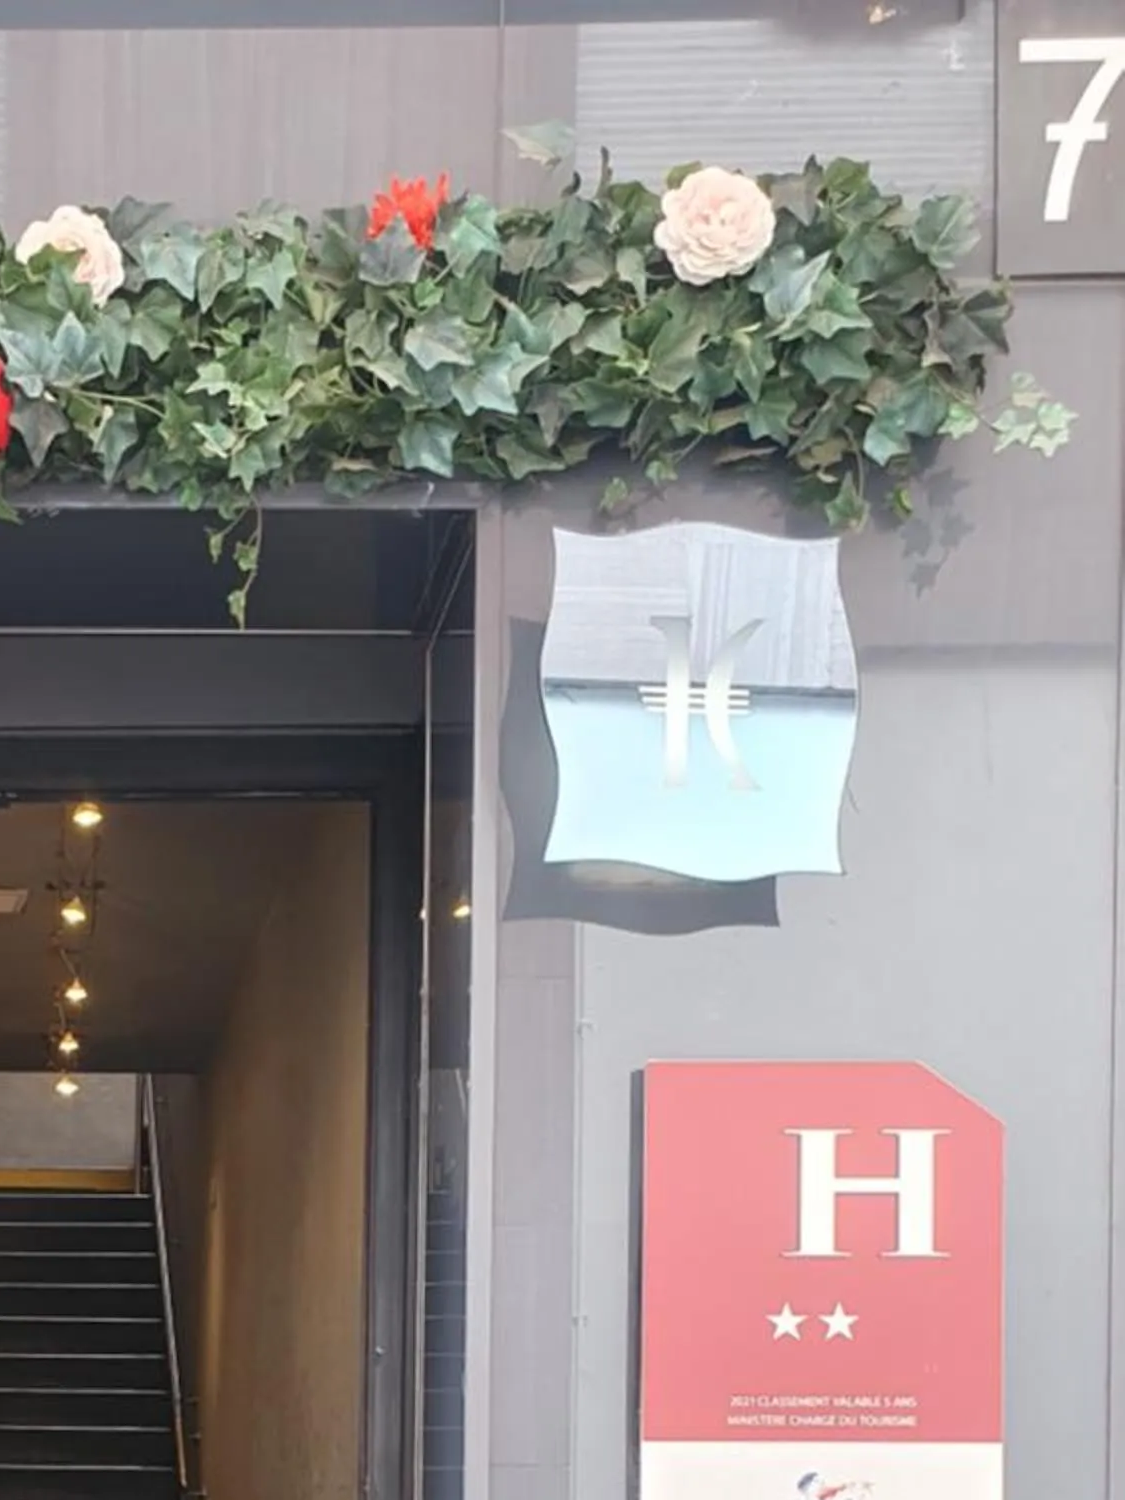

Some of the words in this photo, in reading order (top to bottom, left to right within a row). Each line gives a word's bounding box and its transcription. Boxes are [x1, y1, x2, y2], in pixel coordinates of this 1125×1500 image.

[1019, 37, 1125, 222] 7
[782, 1128, 952, 1258] H
[757, 1395, 829, 1408] CLASSEMENT
[833, 1395, 881, 1408] VALABLE
[893, 1395, 917, 1408] ANS
[838, 1414, 858, 1427] DU
[859, 1414, 918, 1427] TOURISME
